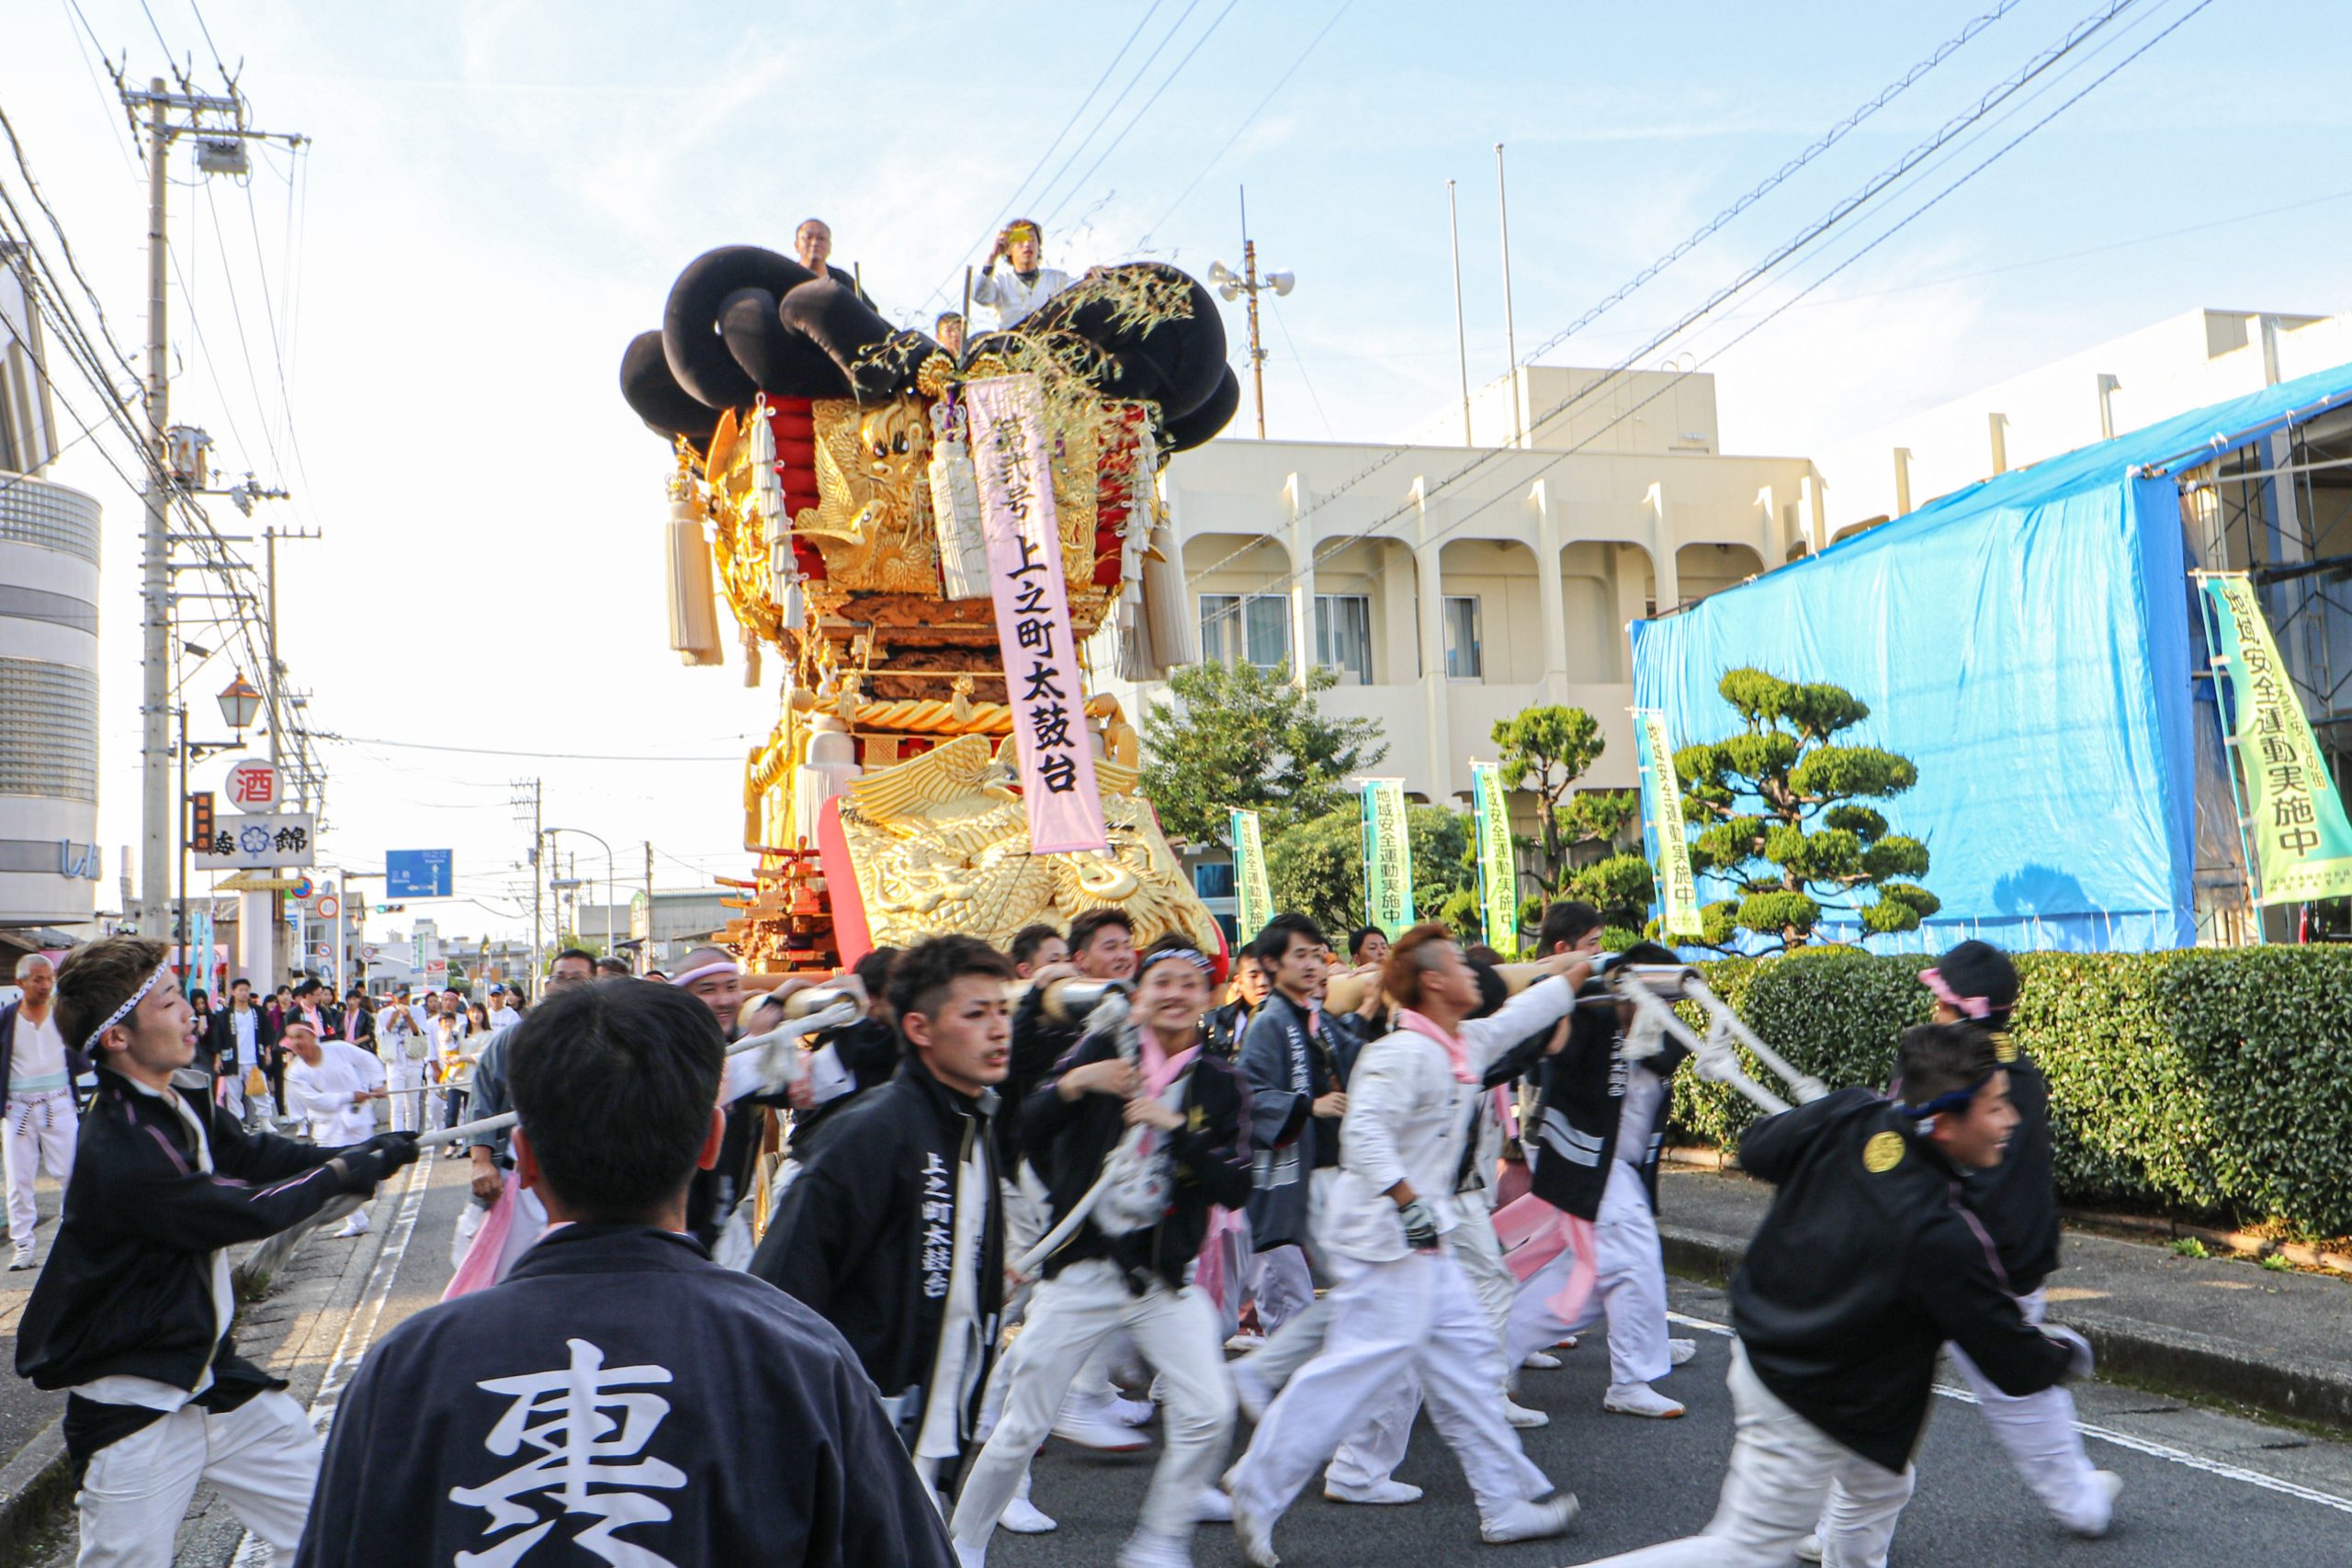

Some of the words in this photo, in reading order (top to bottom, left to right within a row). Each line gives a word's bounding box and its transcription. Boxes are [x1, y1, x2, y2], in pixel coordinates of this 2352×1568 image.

[1007, 536, 1077, 795] 上之町太鼓台
[2221, 587, 2319, 857] 地域安全運動実施中
[236, 768, 274, 803] 酒
[1375, 788, 1401, 924] 地域安全運動実施中
[1483, 773, 1514, 929] 地域安全運動実施中
[1645, 720, 1695, 906] 地域安全運動実施中
[920, 1152, 954, 1298] 上之町太鼓台
